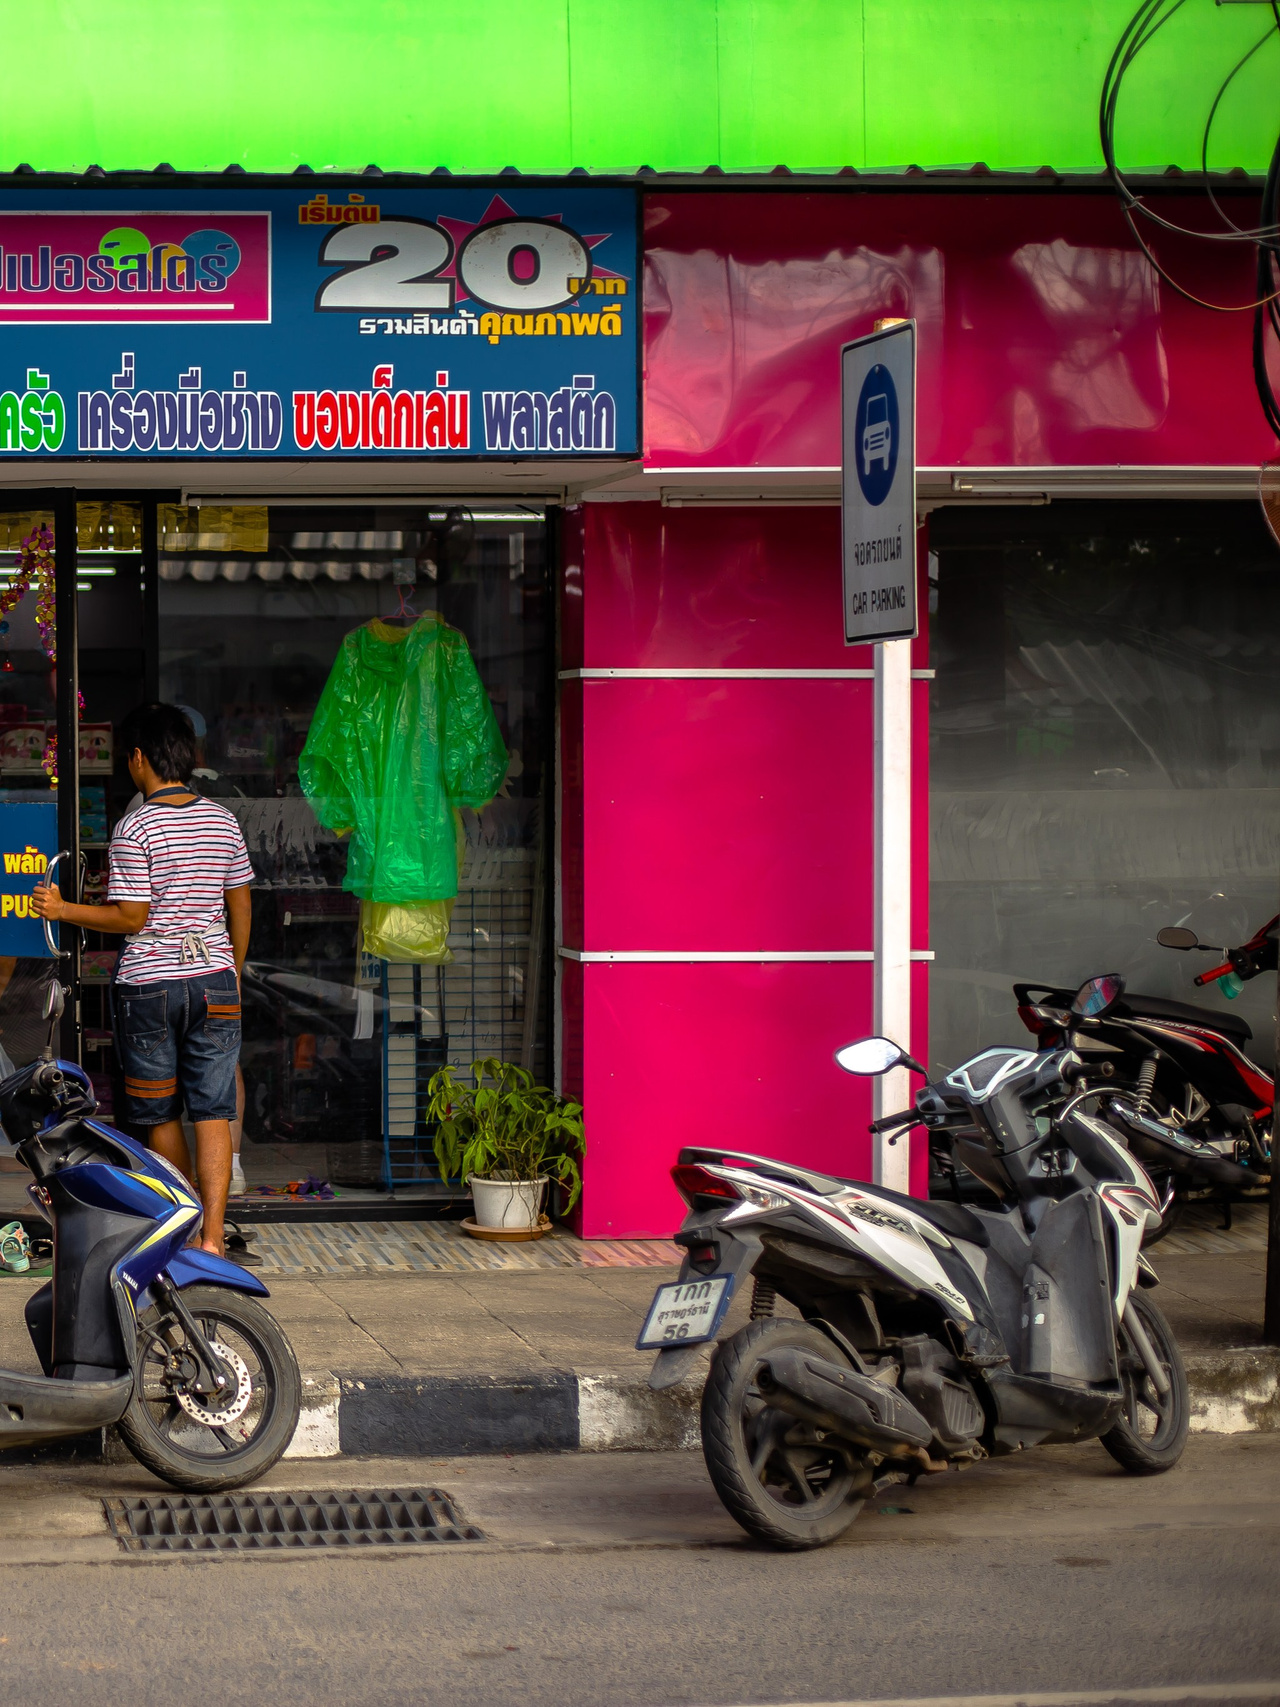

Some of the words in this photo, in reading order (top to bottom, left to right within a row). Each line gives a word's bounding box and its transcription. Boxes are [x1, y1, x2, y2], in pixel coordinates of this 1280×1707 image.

[298, 193, 380, 224] เริ่มต้น
[314, 214, 593, 313] 20
[567, 276, 628, 295] บาท
[77, 351, 283, 452] เครื่องมือช่าง
[292, 364, 470, 451] ของเด็กเล่น
[483, 373, 617, 452] พลาสติก
[853, 591, 868, 615] CAR
[871, 585, 906, 613] PARKING
[662, 1322, 690, 1340] 56
